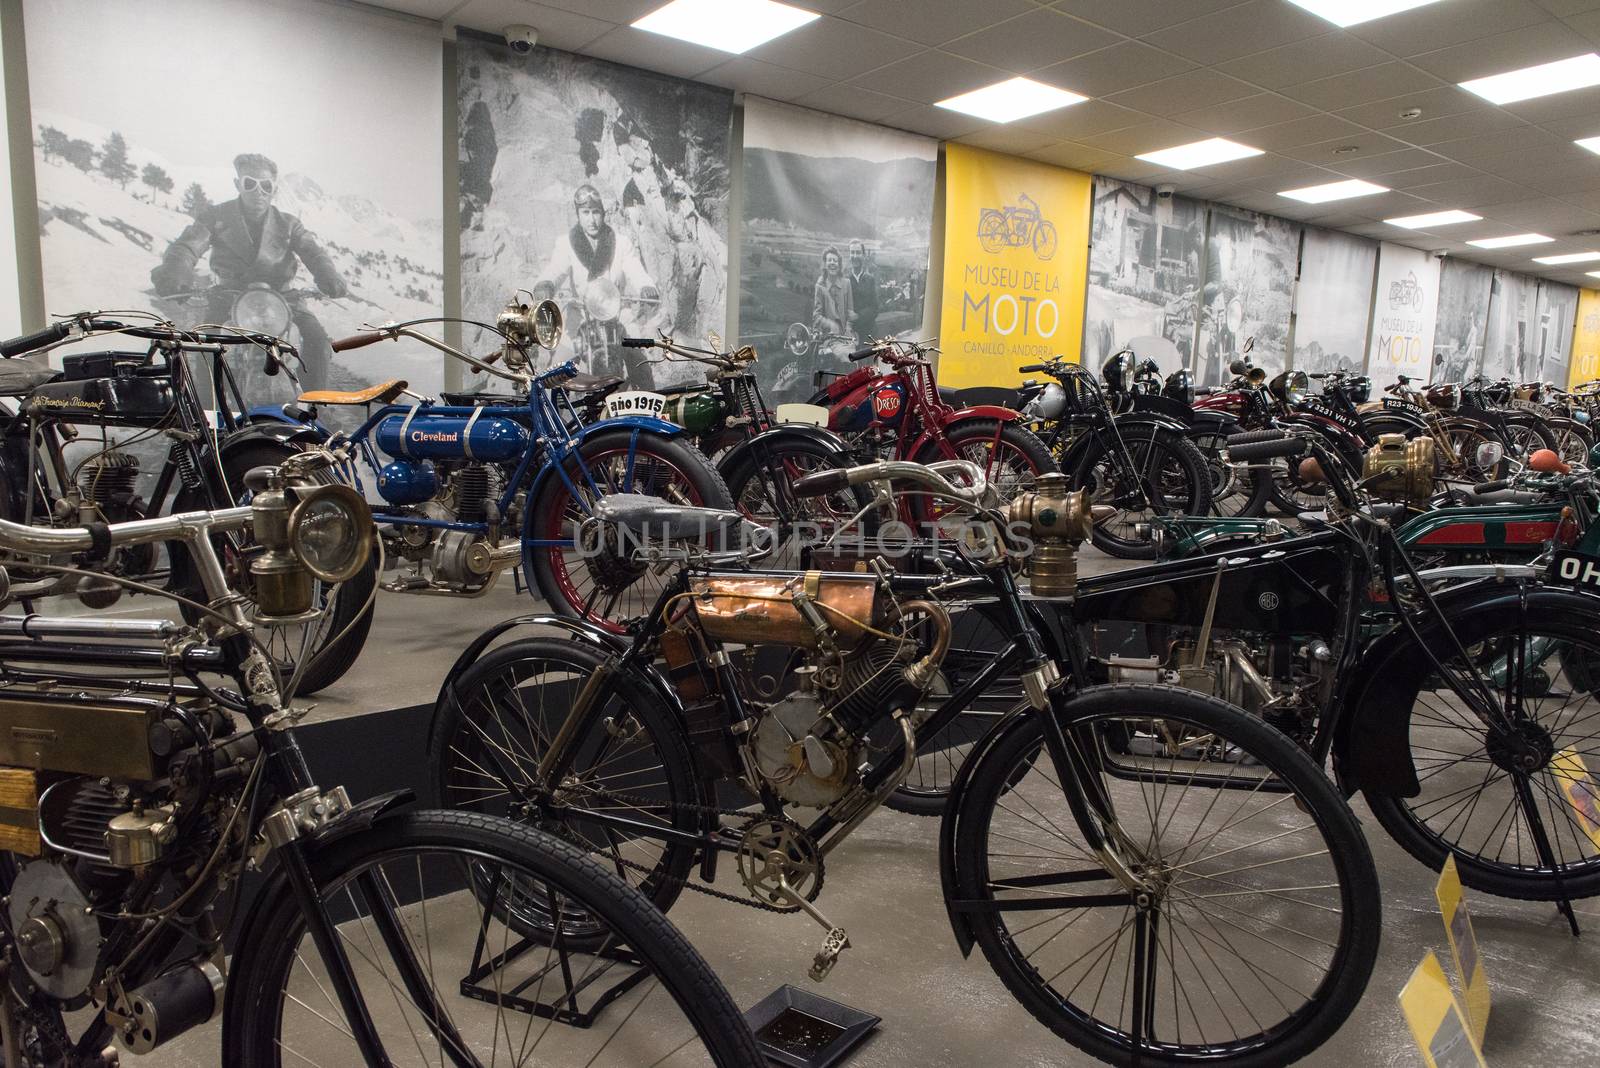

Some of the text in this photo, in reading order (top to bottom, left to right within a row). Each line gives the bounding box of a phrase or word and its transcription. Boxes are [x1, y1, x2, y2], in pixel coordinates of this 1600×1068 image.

[964, 263, 1060, 294] MUSEU DE LA
[961, 289, 1060, 339] MOTO
[963, 341, 1006, 356] CANILLO
[1011, 344, 1054, 357] ANDORRA
[1377, 335, 1422, 365] MOTO
[634, 397, 663, 412] 1915
[1314, 404, 1357, 428] 3231 VH 17
[411, 431, 458, 442] Cleveland
